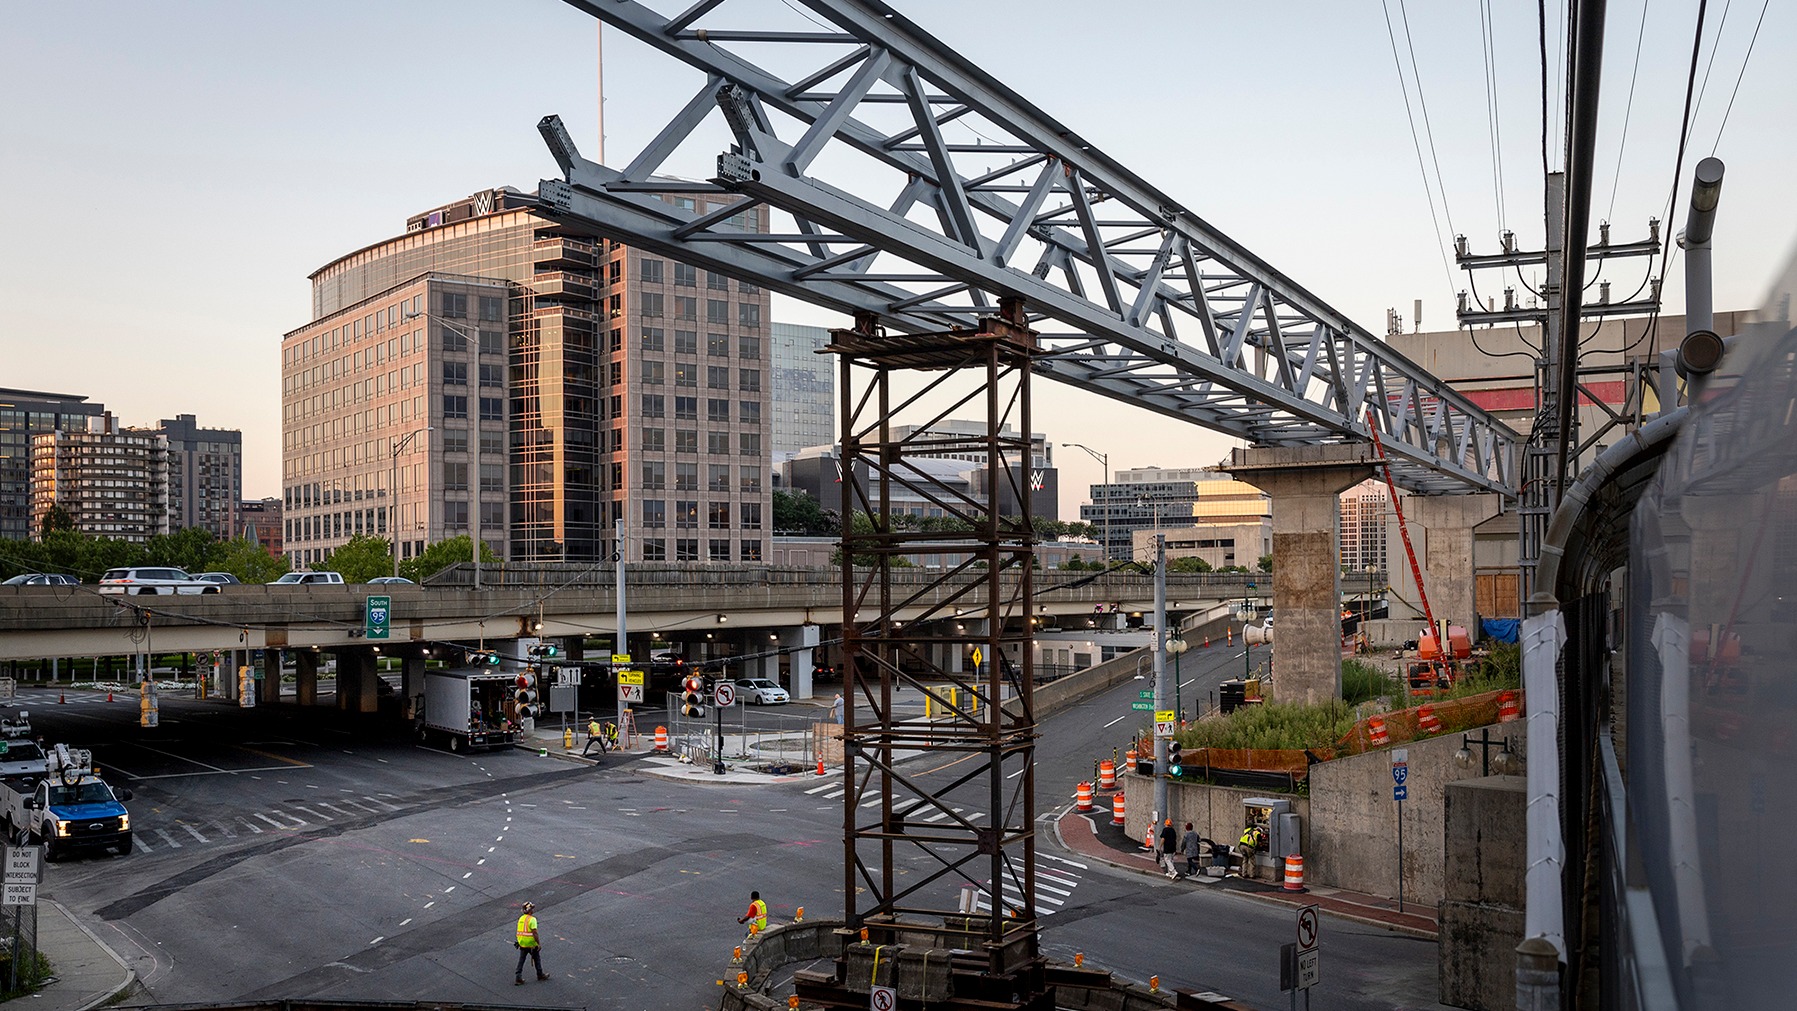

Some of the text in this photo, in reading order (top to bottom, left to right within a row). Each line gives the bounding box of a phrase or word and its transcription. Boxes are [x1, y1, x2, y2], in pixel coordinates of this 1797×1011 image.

[372, 612, 384, 620] 95
[1394, 769, 1406, 780] 95
[1301, 957, 1316, 970] NO LEFT
[1303, 971, 1314, 981] TURN
